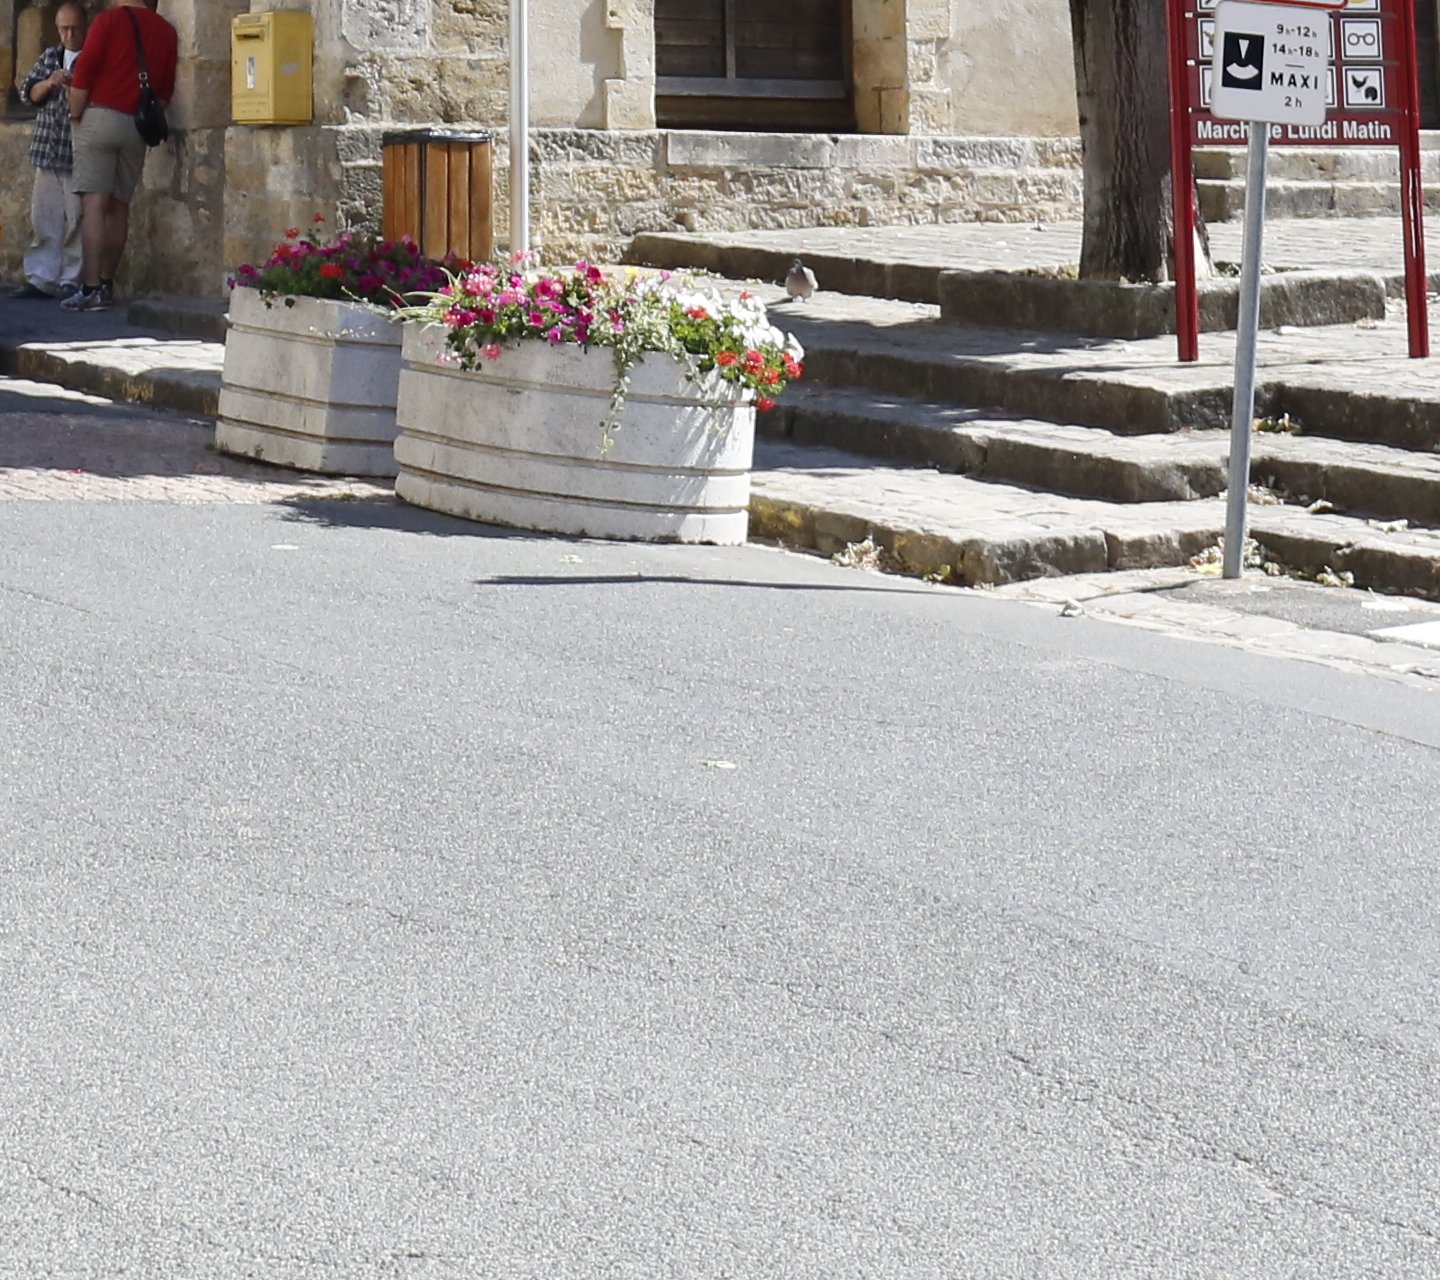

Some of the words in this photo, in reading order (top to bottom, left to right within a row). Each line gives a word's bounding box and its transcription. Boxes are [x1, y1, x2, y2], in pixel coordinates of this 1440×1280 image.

[1269, 72, 1318, 90] MAXI
[1197, 120, 1250, 139] March
[1288, 121, 1337, 139] Lundi
[1343, 121, 1391, 140] Matin
